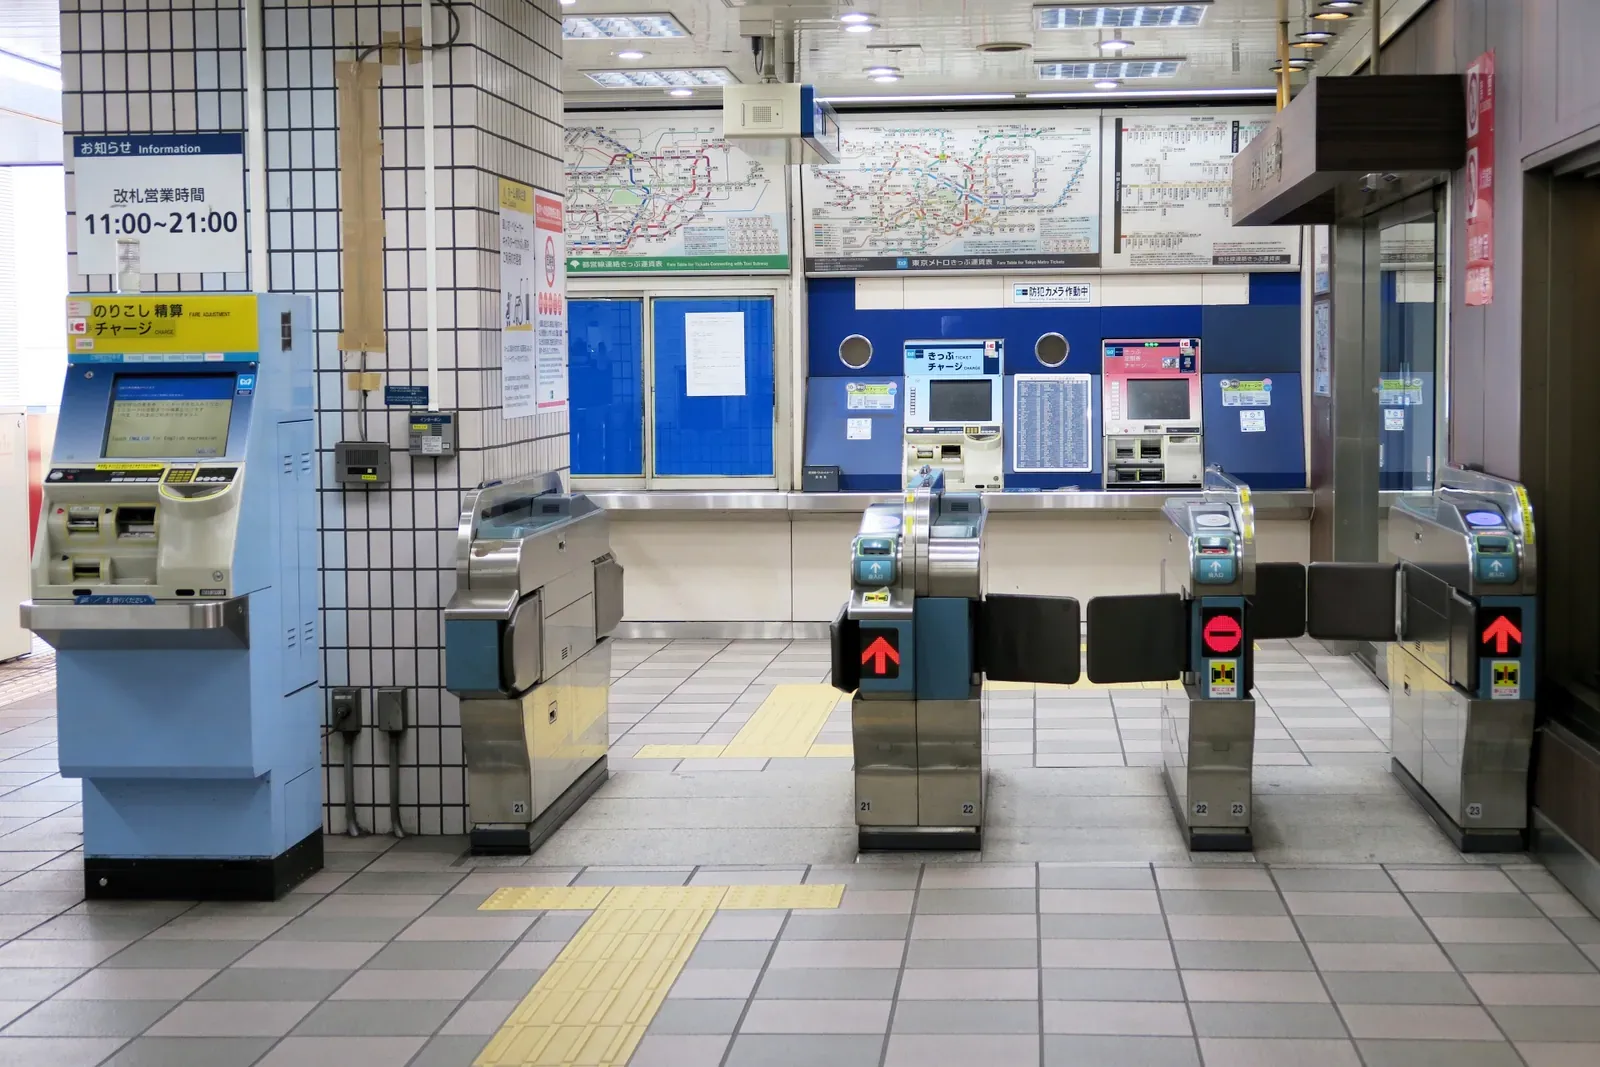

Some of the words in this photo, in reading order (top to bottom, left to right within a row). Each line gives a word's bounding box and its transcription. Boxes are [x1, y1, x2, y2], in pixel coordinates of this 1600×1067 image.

[80, 141, 132, 155] お知らせ
[138, 144, 201, 154] Information
[113, 187, 205, 204] 改札営業時間
[911, 259, 993, 267] 東京メトロきっぷ運賃表
[1029, 286, 1088, 297] 防犯カメラ作動中
[93, 304, 150, 318] のりこし
[154, 303, 183, 318] 精算
[95, 321, 152, 336] チャージ
[928, 351, 954, 361] きっぷ
[928, 362, 963, 371] チャージ
[514, 803, 524, 813] 21
[861, 801, 871, 811] 21
[963, 804, 974, 814] 22
[1196, 804, 1207, 814] 22
[1232, 804, 1243, 814] 23
[1469, 806, 1480, 816] 23
